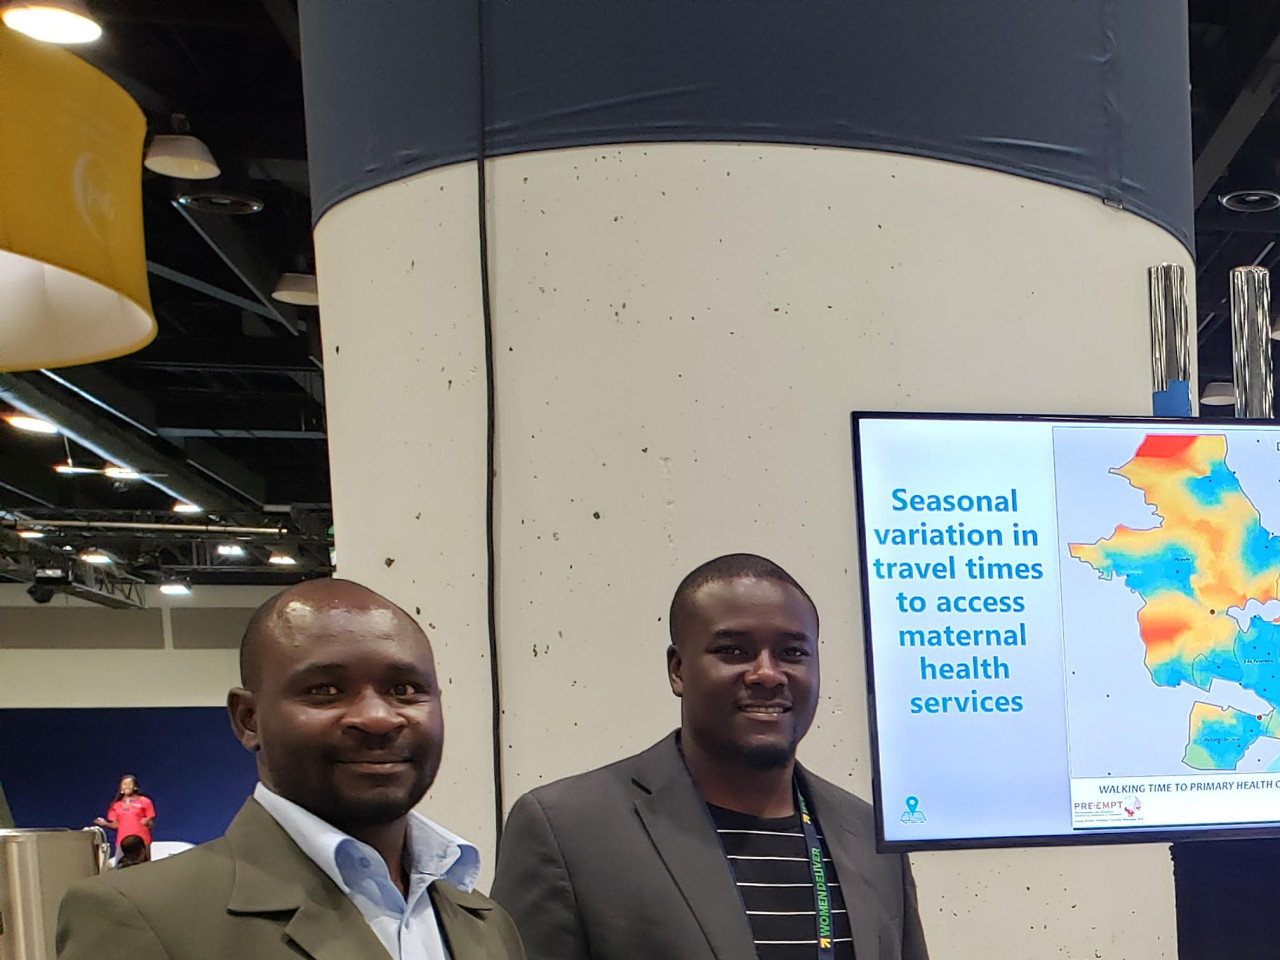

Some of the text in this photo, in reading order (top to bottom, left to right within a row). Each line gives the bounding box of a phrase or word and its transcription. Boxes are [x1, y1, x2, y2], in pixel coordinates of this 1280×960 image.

[891, 488, 1018, 512] Seasonal
[874, 522, 1039, 547] variation in
[873, 555, 1044, 580] travel times
[896, 592, 1025, 613] to access
[898, 623, 1027, 647] maternal
[920, 656, 1010, 680] health
[910, 689, 1024, 713] services
[1099, 784, 1146, 794] WALKING
[1148, 783, 1173, 792] TIME
[1175, 783, 1188, 792] TO
[1190, 781, 1234, 791] PRIMARY
[1236, 780, 1273, 790] HEALTH
[811, 848, 831, 936] WOMEN DELIVER
